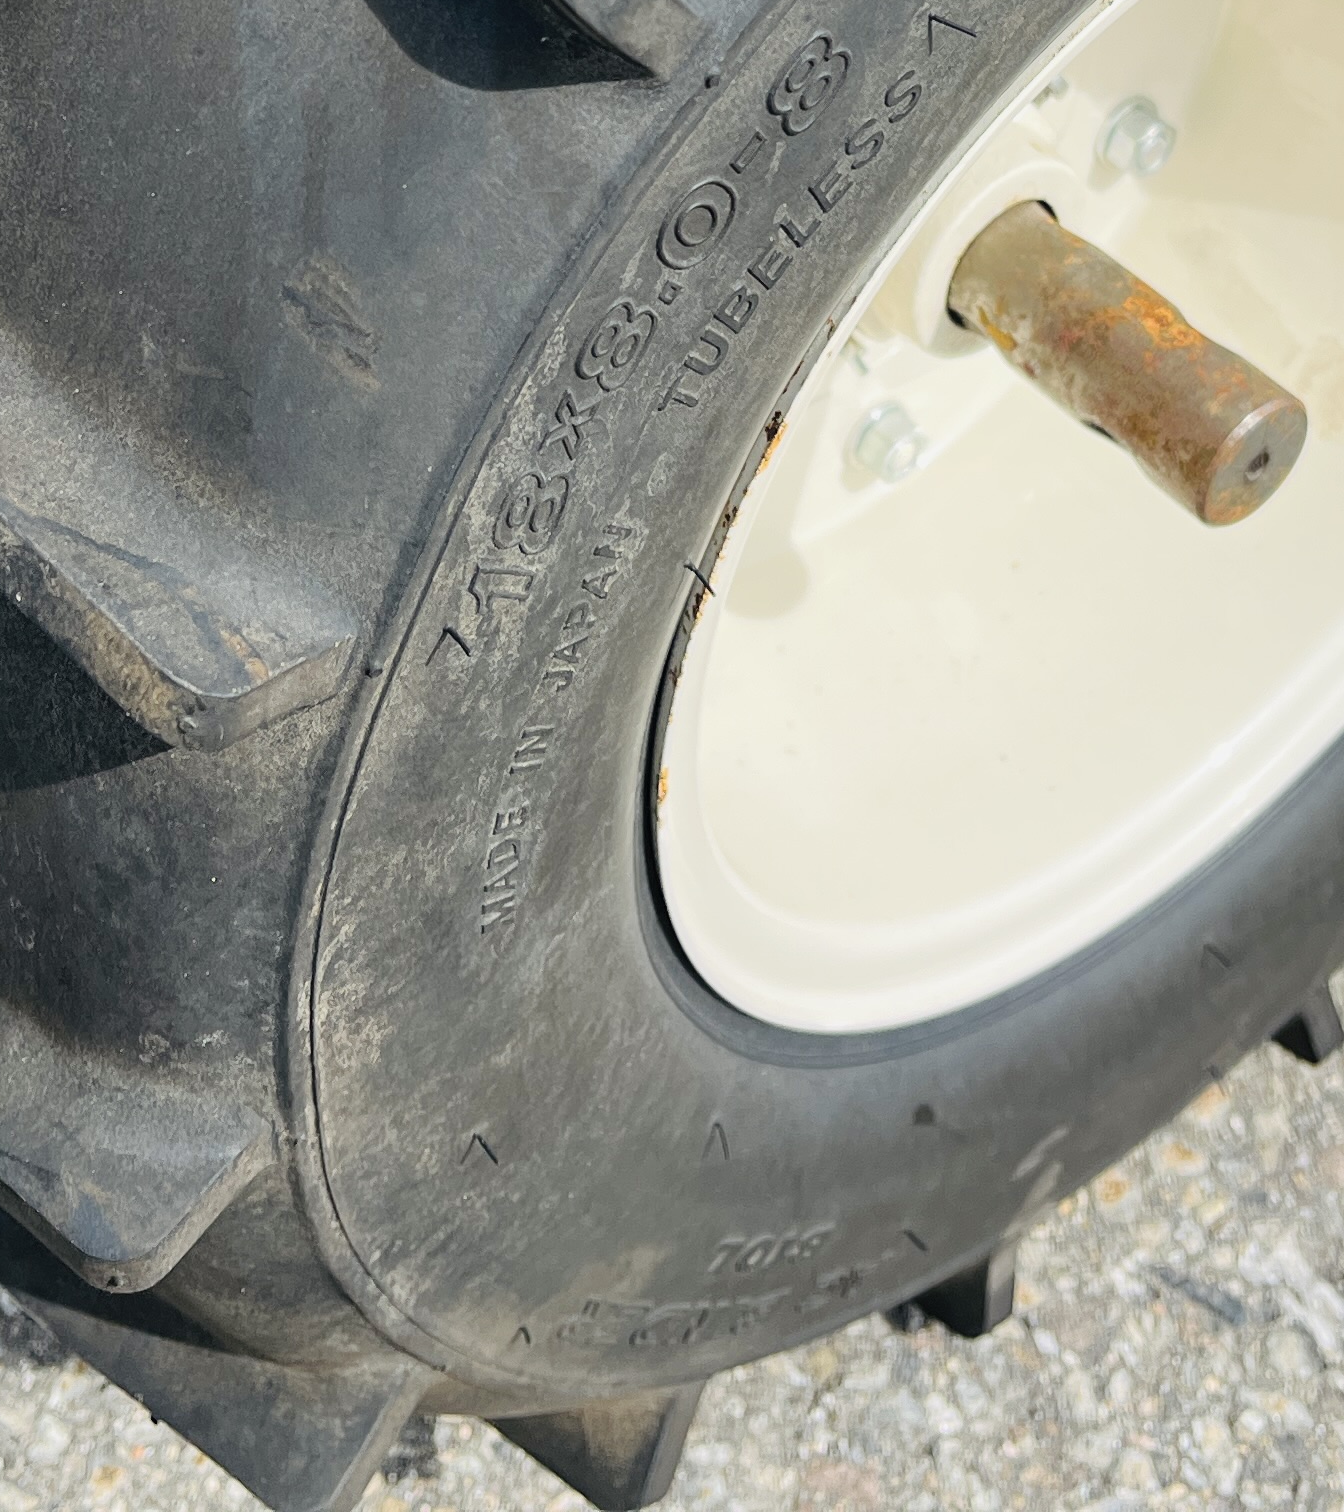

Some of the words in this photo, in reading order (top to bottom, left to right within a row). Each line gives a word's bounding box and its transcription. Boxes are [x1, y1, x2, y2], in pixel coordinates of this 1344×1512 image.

[656, 68, 925, 413] TUBELESS
[480, 803, 529, 935] MADE
[508, 723, 556, 778] IN
[541, 522, 634, 693] JAPAN
